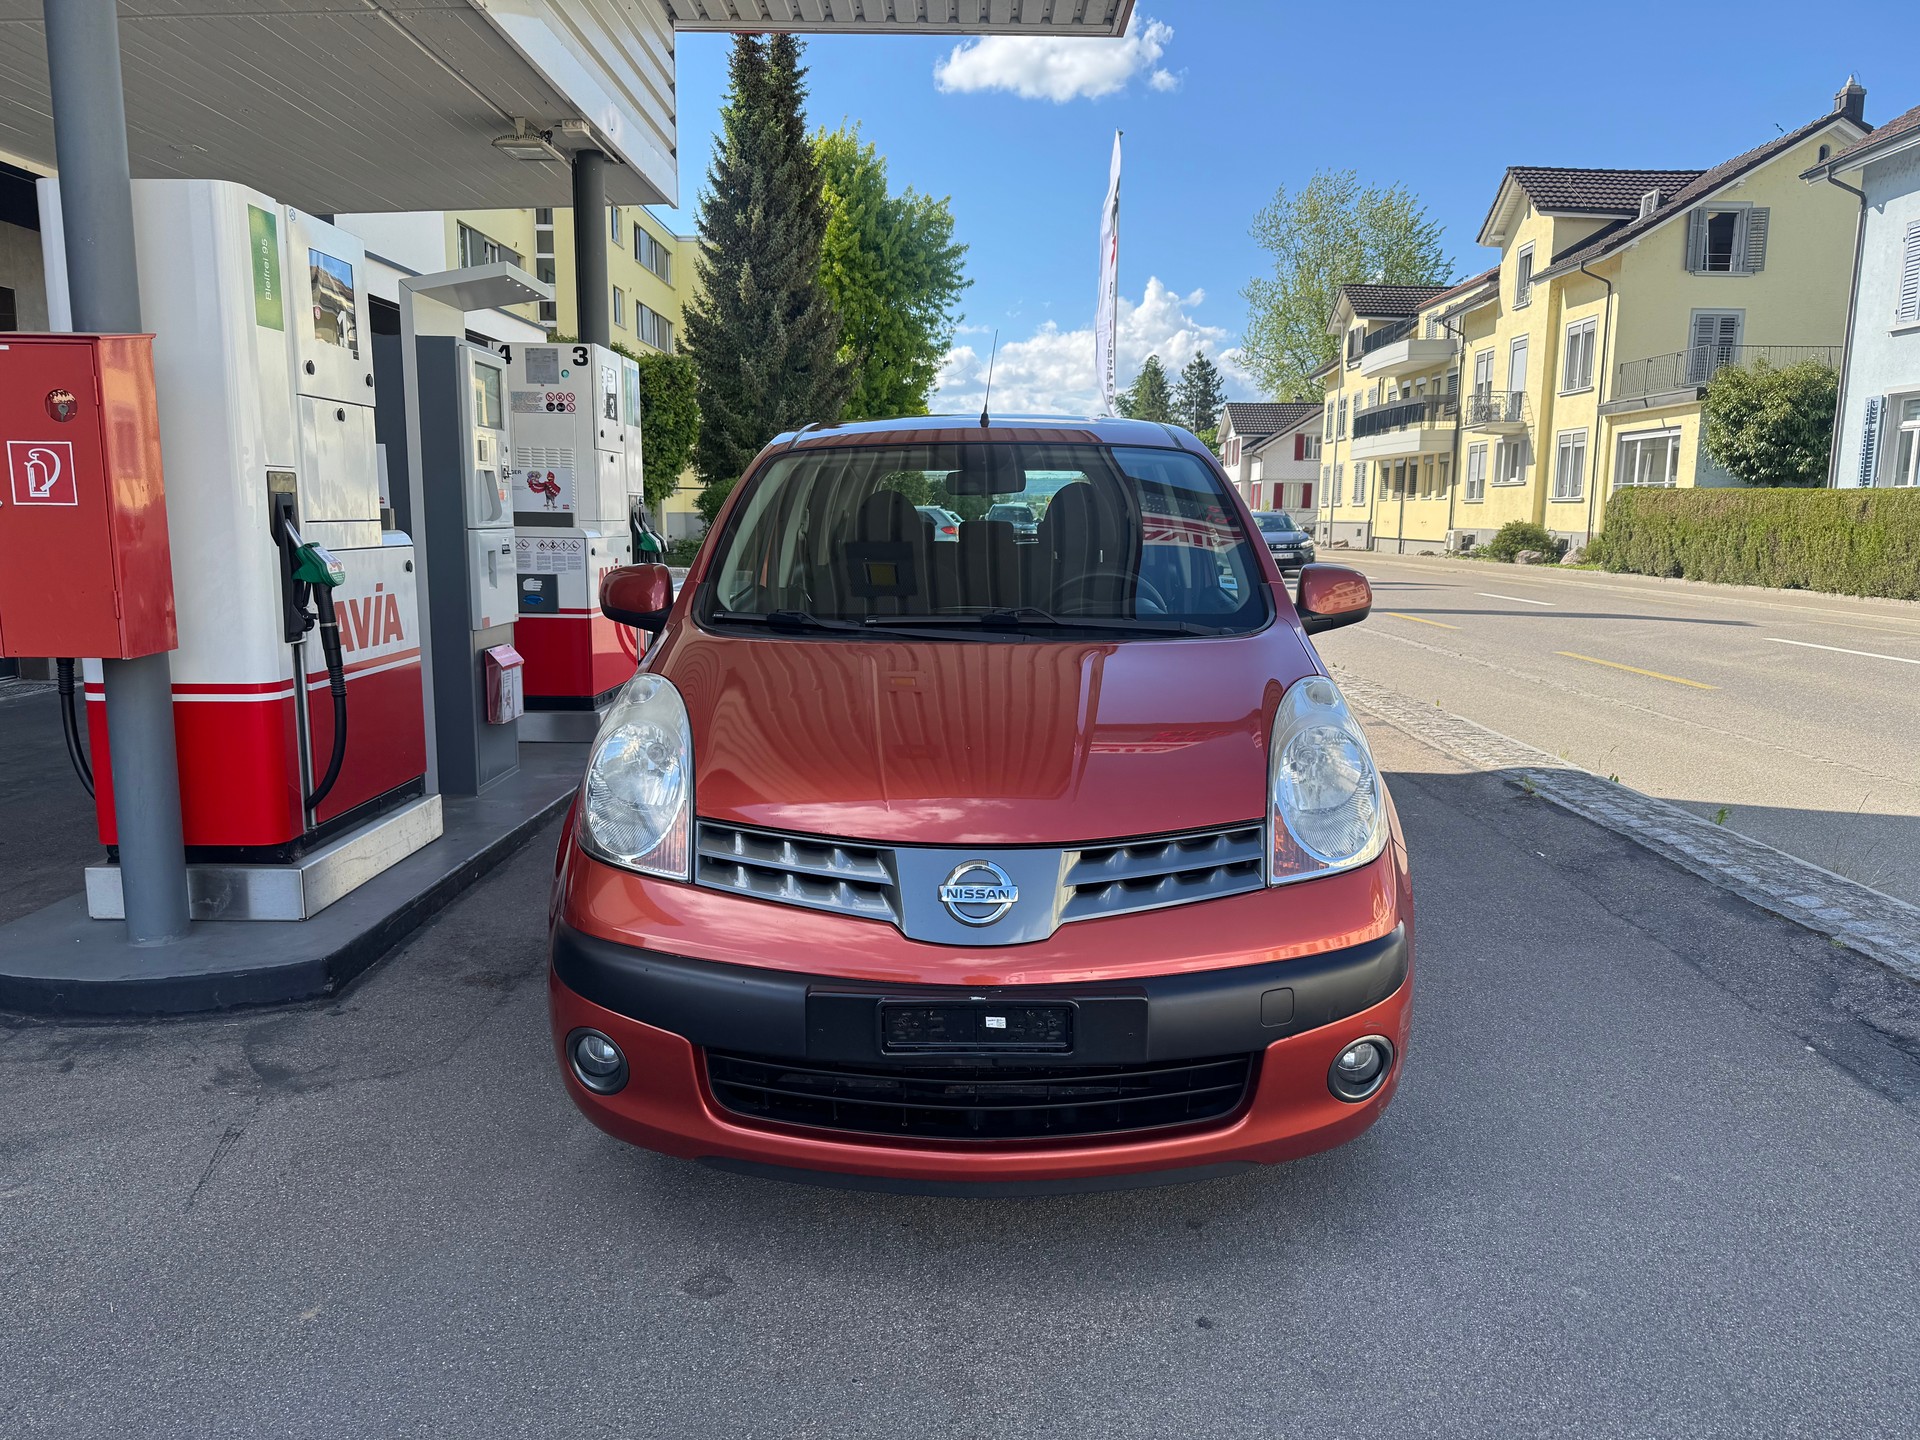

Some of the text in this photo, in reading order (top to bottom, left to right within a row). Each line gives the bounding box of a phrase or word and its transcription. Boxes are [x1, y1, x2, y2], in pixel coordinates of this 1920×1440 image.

[261, 238, 272, 301] Bleifrei 95
[498, 344, 513, 365] 4
[572, 346, 589, 367] 3
[946, 888, 1010, 900] NISSAN
